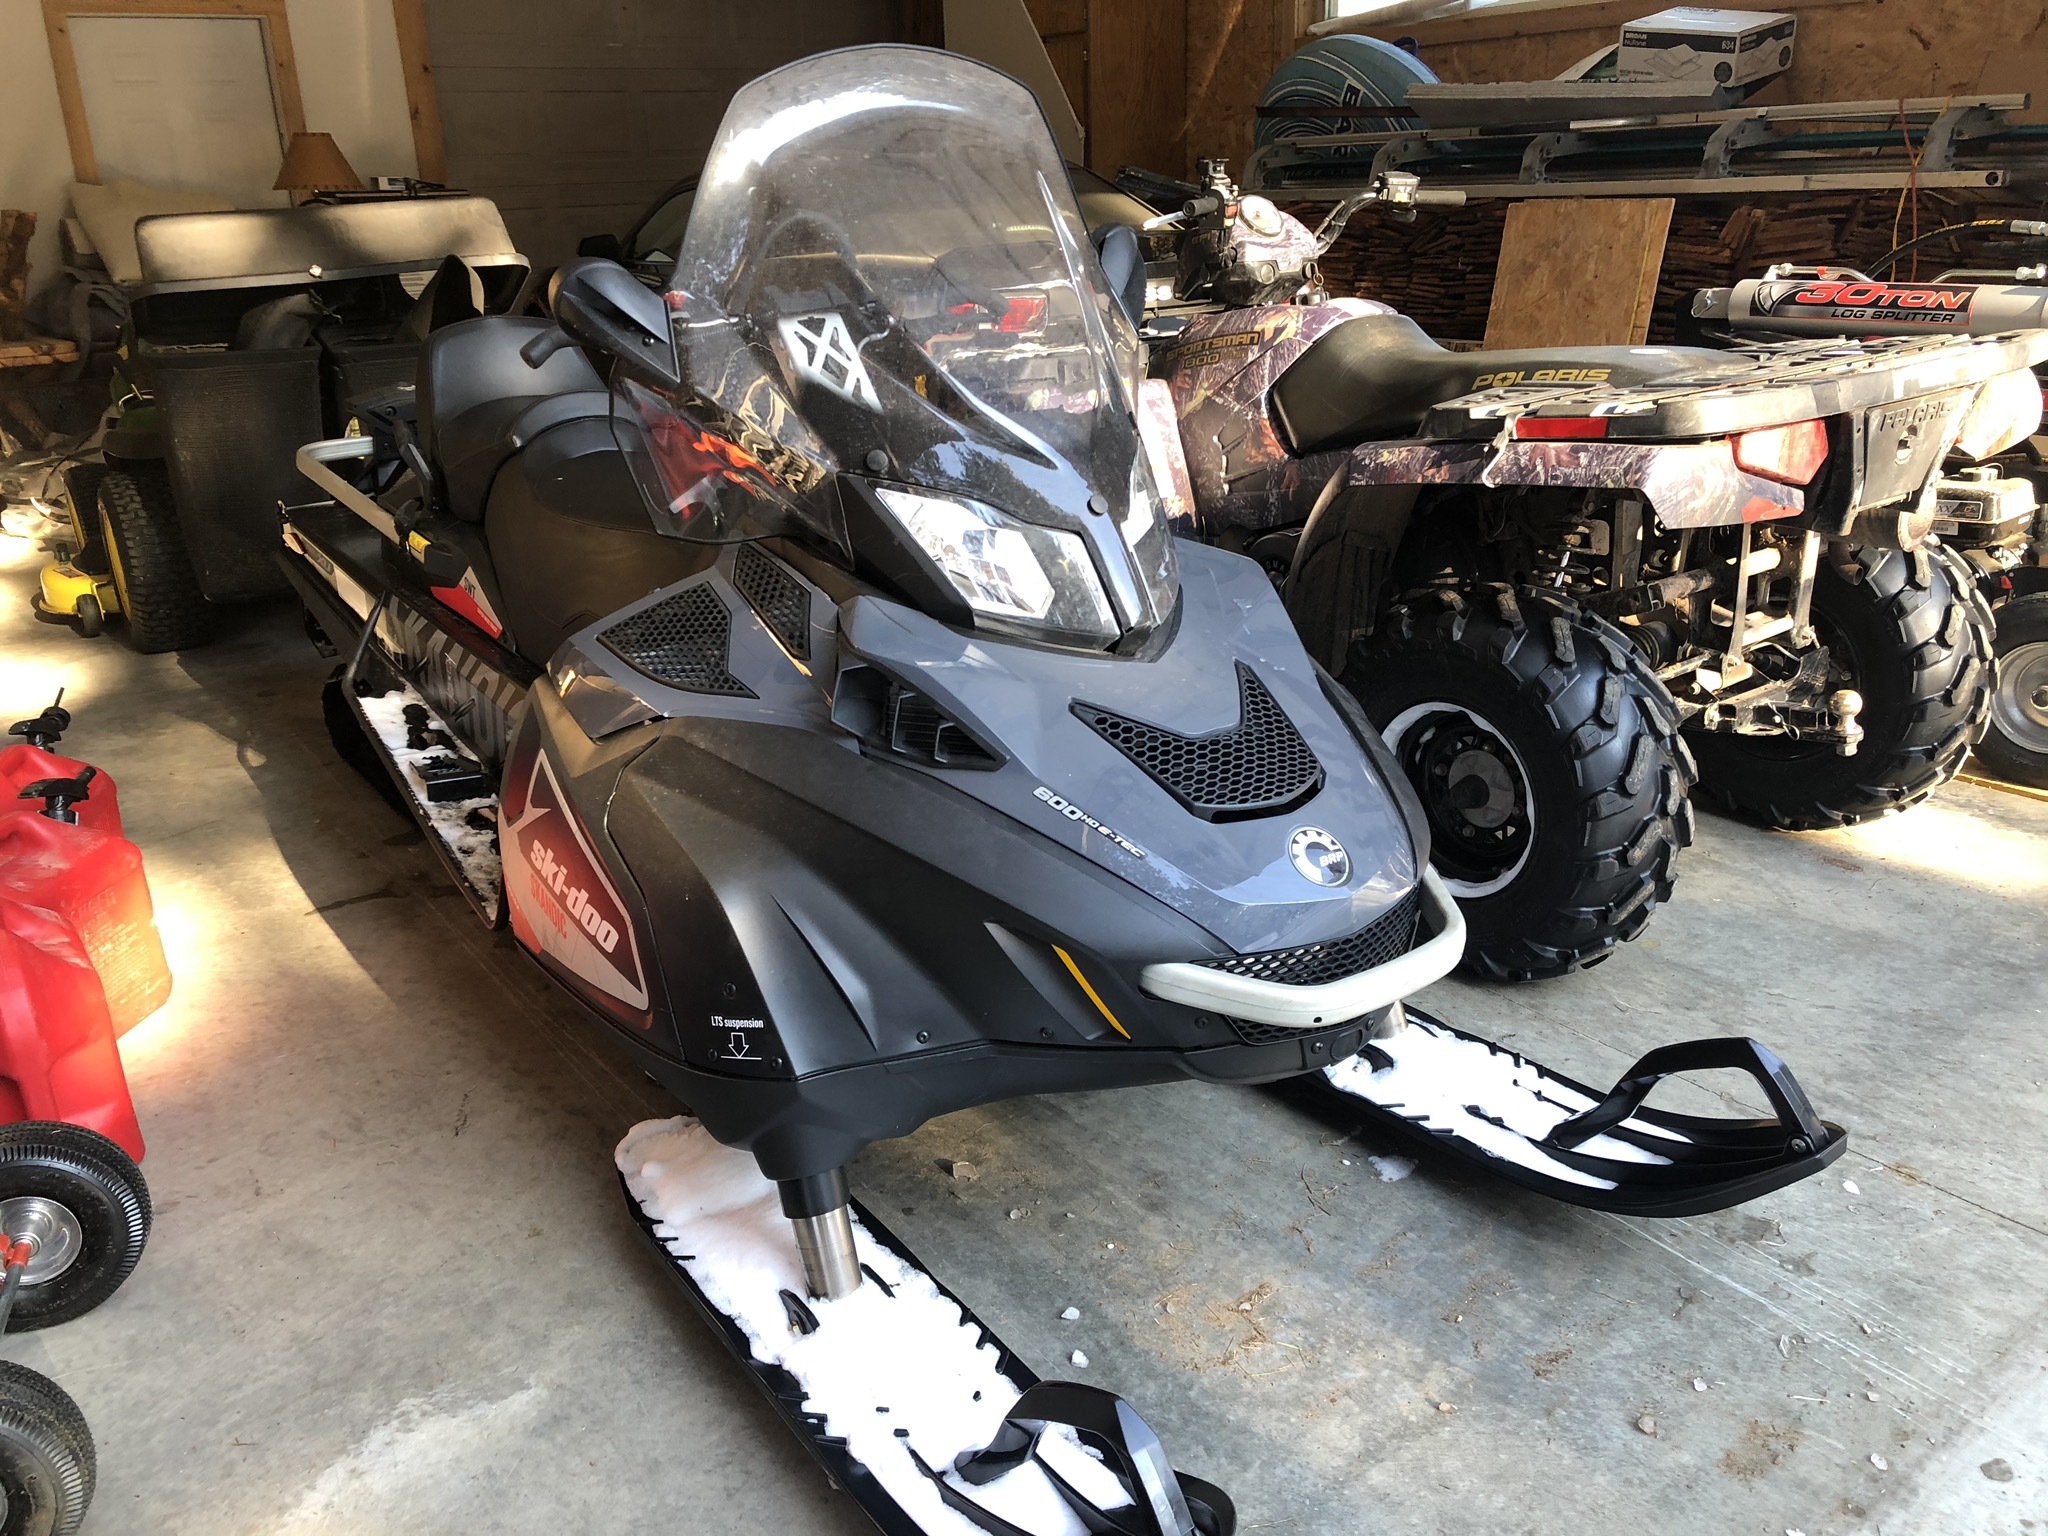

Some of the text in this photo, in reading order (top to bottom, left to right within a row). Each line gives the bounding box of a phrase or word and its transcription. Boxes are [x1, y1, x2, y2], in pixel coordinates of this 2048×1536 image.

[1721, 40, 1735, 51] 634
[1831, 309, 1956, 323] LOG SPLITTER
[1166, 333, 1259, 361] SPORTSMAN
[1185, 353, 1220, 368] 800
[1471, 369, 1612, 391] POLARIS
[463, 576, 476, 600] SWT
[1033, 786, 1084, 821] 600
[1097, 826, 1146, 858] E-TEC
[1319, 851, 1344, 867] BRP
[530, 839, 620, 954] ski-doo
[530, 873, 568, 940] SKANDIC
[710, 1015, 764, 1030] LTS suspension
